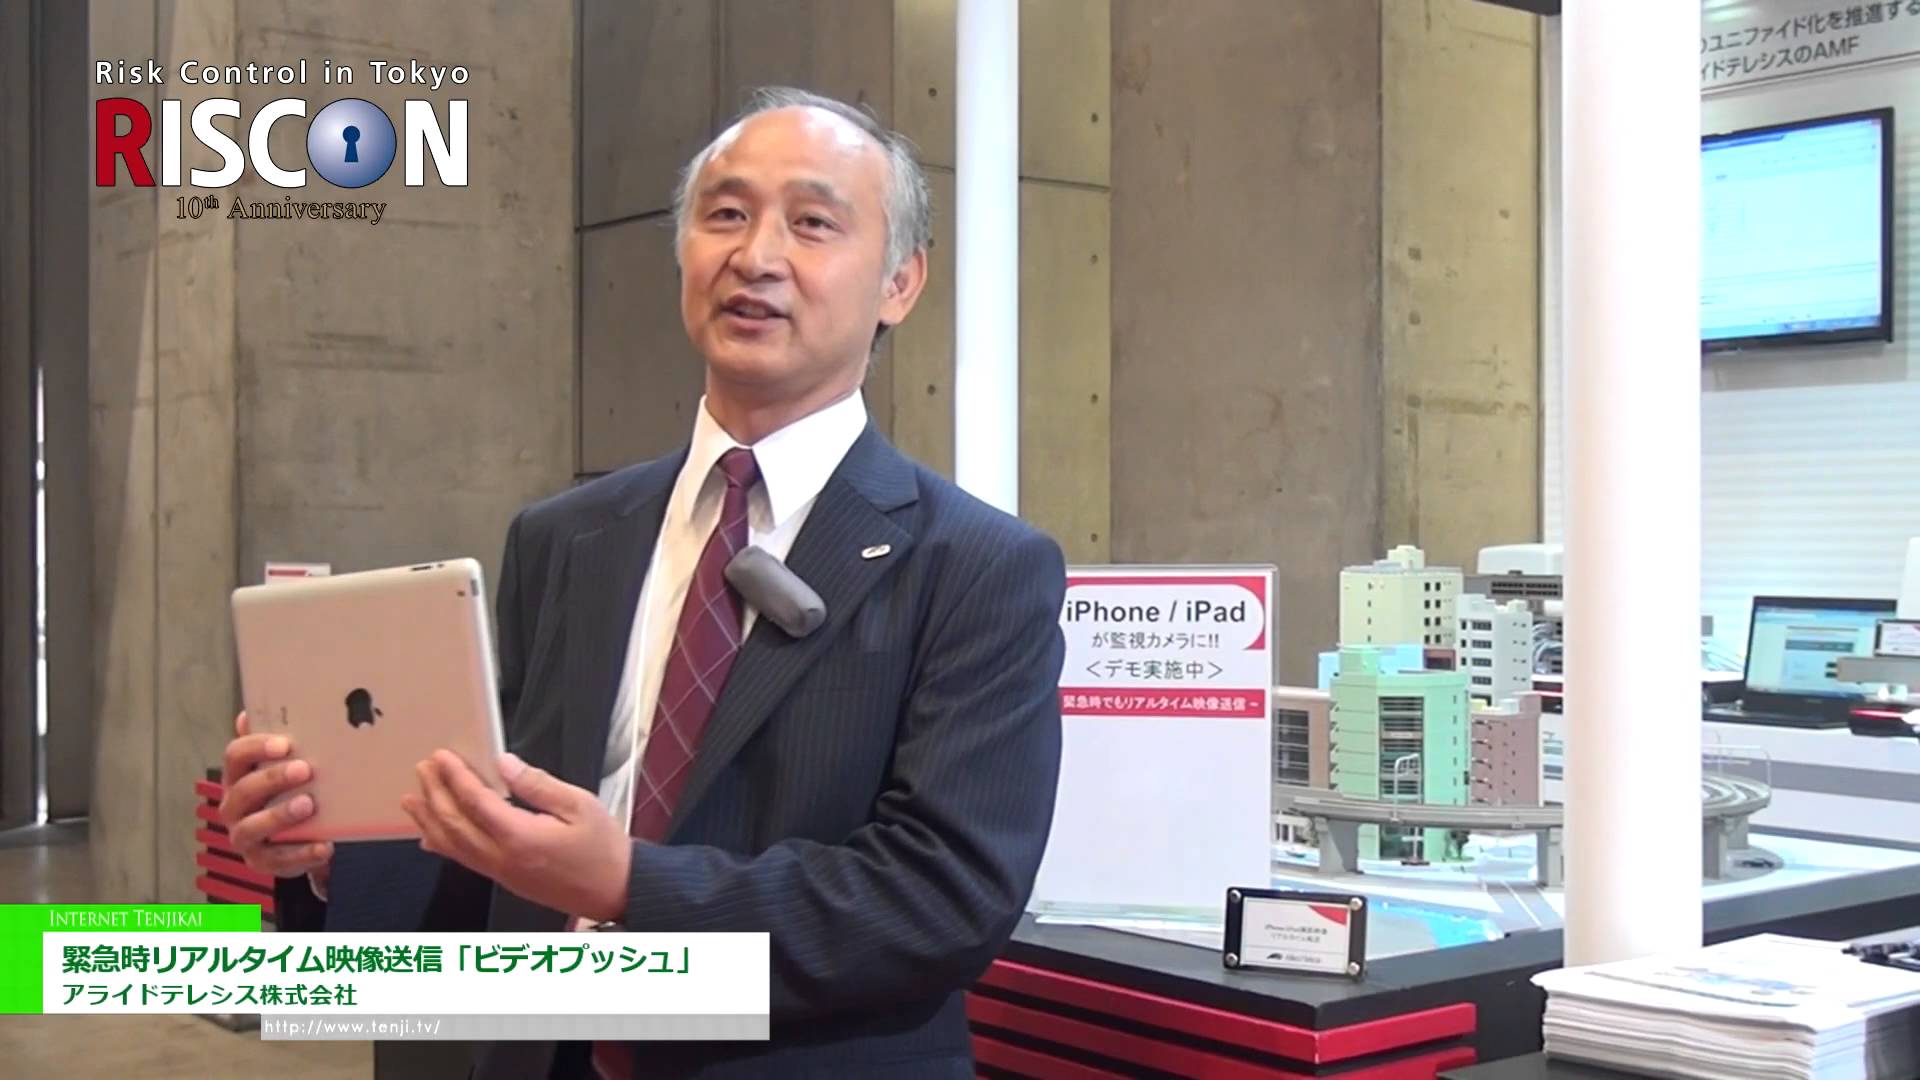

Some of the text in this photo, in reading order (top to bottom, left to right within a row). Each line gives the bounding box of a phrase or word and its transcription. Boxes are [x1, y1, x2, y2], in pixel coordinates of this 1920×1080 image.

[1066, 600, 1246, 623] iPhone / iPad
